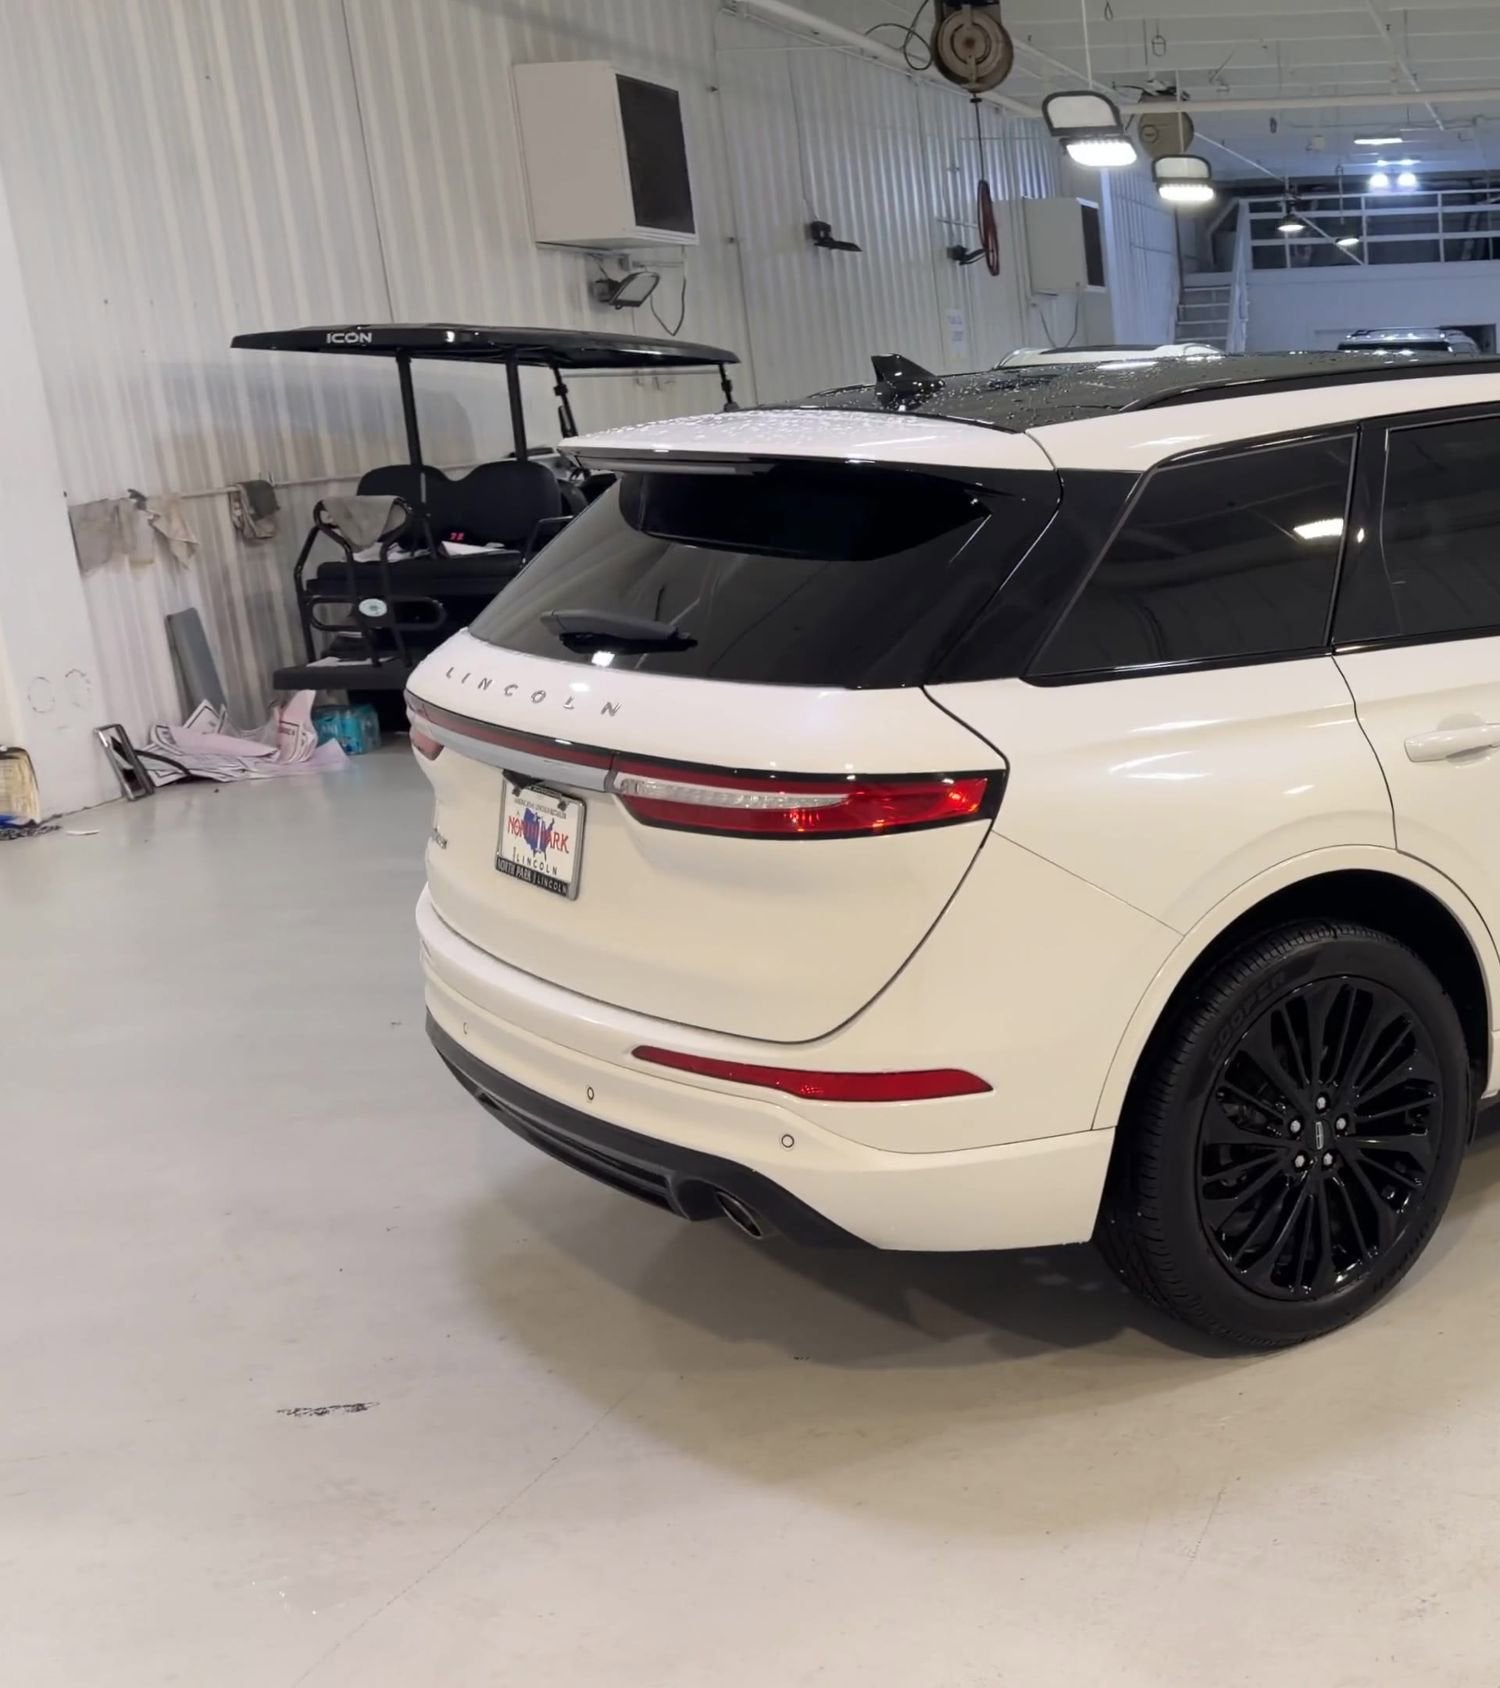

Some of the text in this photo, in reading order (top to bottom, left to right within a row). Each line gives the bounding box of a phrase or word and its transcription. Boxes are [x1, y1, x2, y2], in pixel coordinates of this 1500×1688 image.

[326, 332, 373, 344] ICON
[445, 666, 623, 718] LINCOLN
[516, 853, 558, 875] LINCOLN
[515, 865, 532, 882] PARK
[537, 875, 567, 894] LINCOLN
